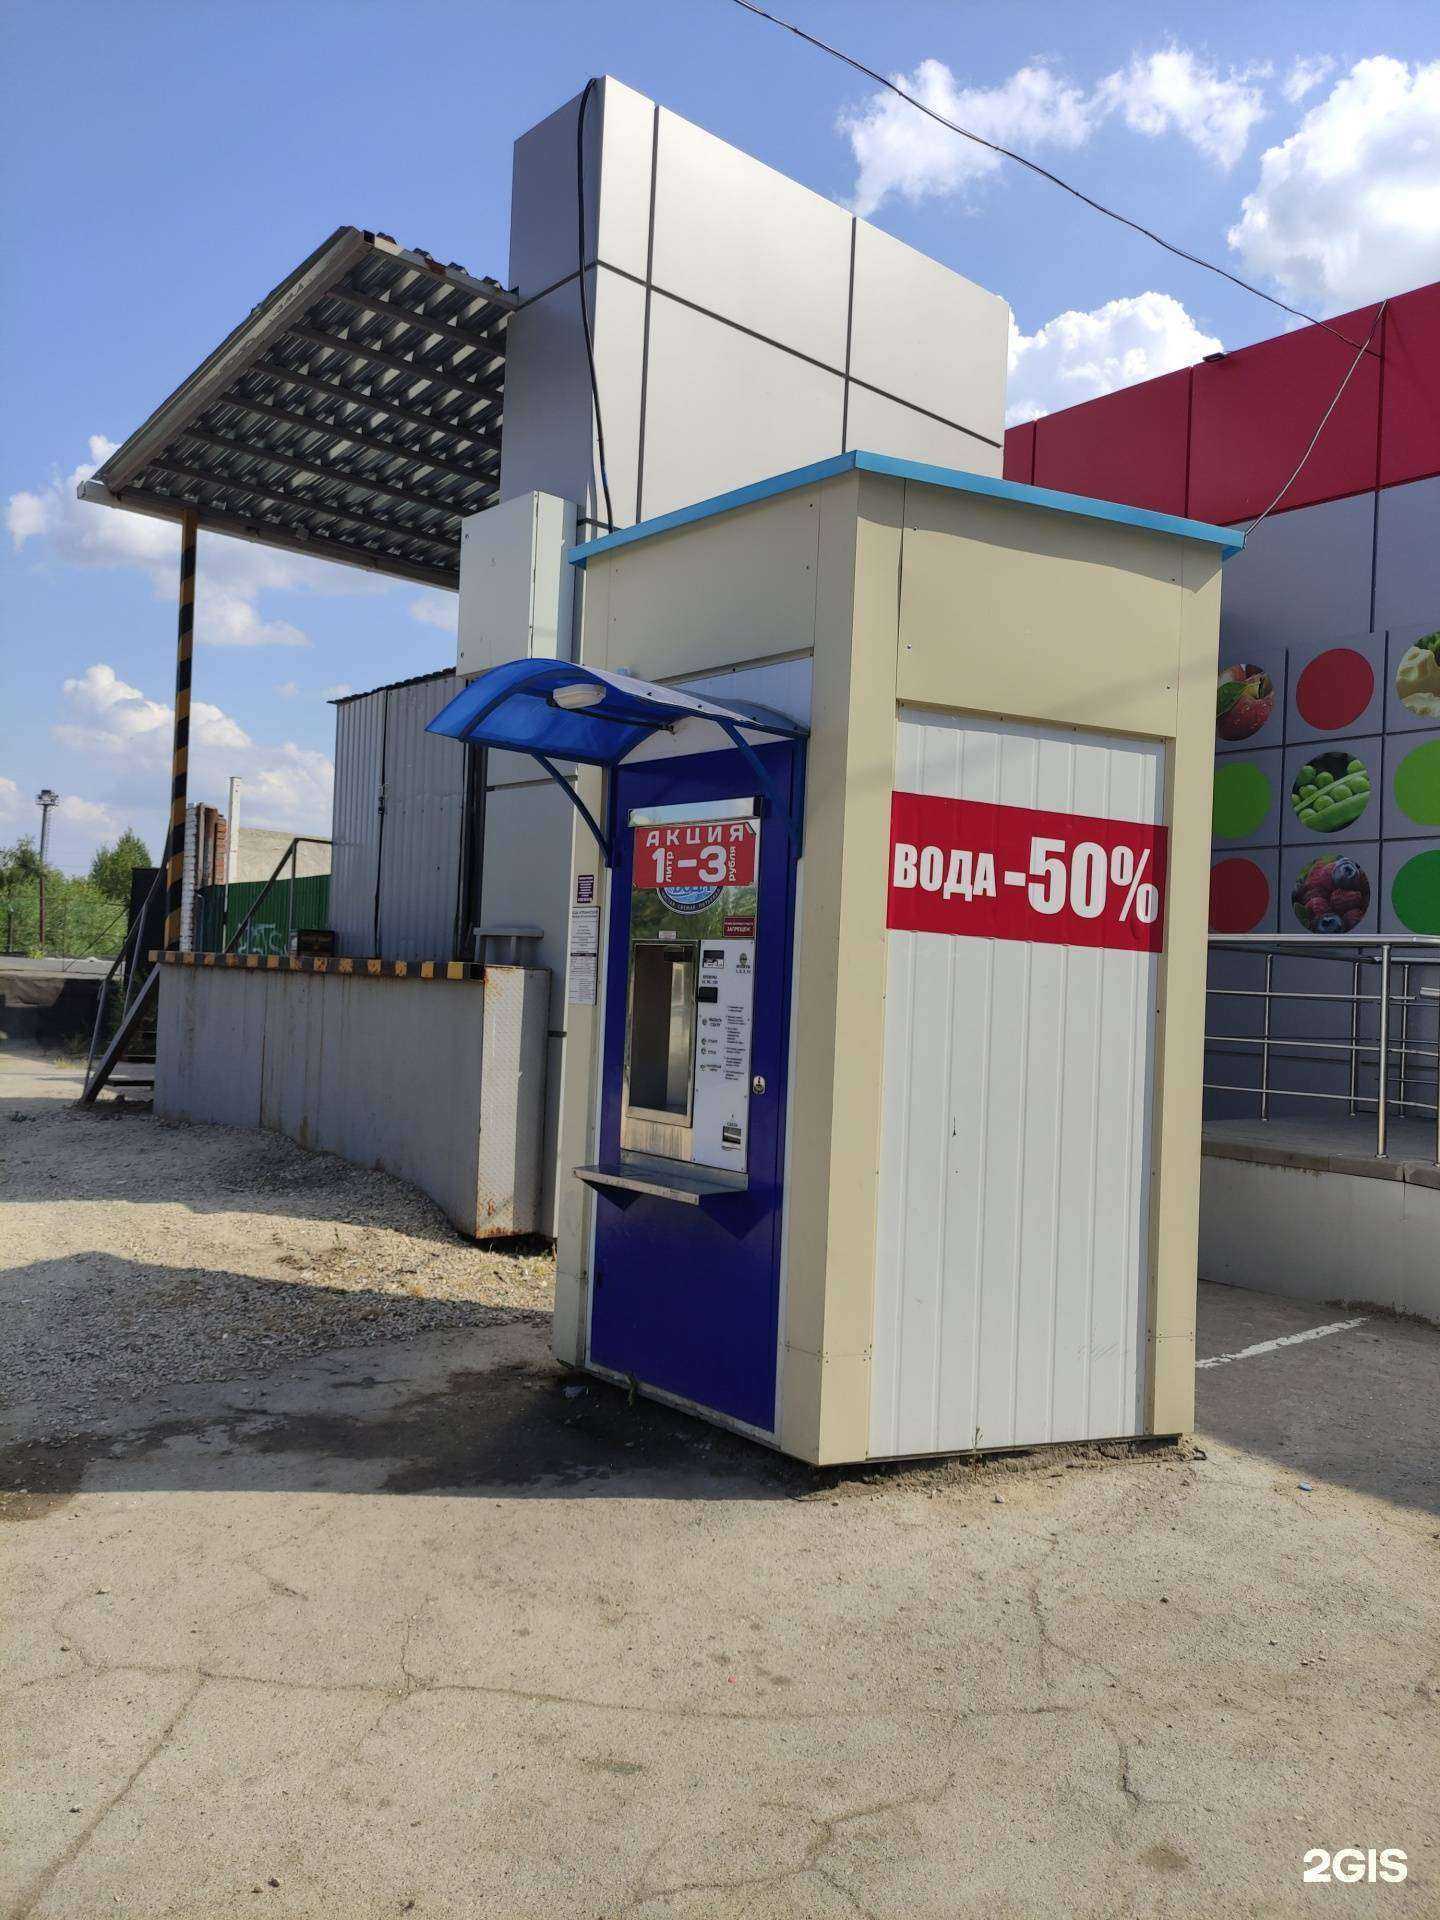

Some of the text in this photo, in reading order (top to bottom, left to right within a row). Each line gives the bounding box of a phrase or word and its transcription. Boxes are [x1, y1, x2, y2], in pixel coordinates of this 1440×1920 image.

[646, 825, 744, 847] АКЦИЯ
[652, 847, 665, 883] 1
[893, 836, 1159, 924] ВОДА -50%
